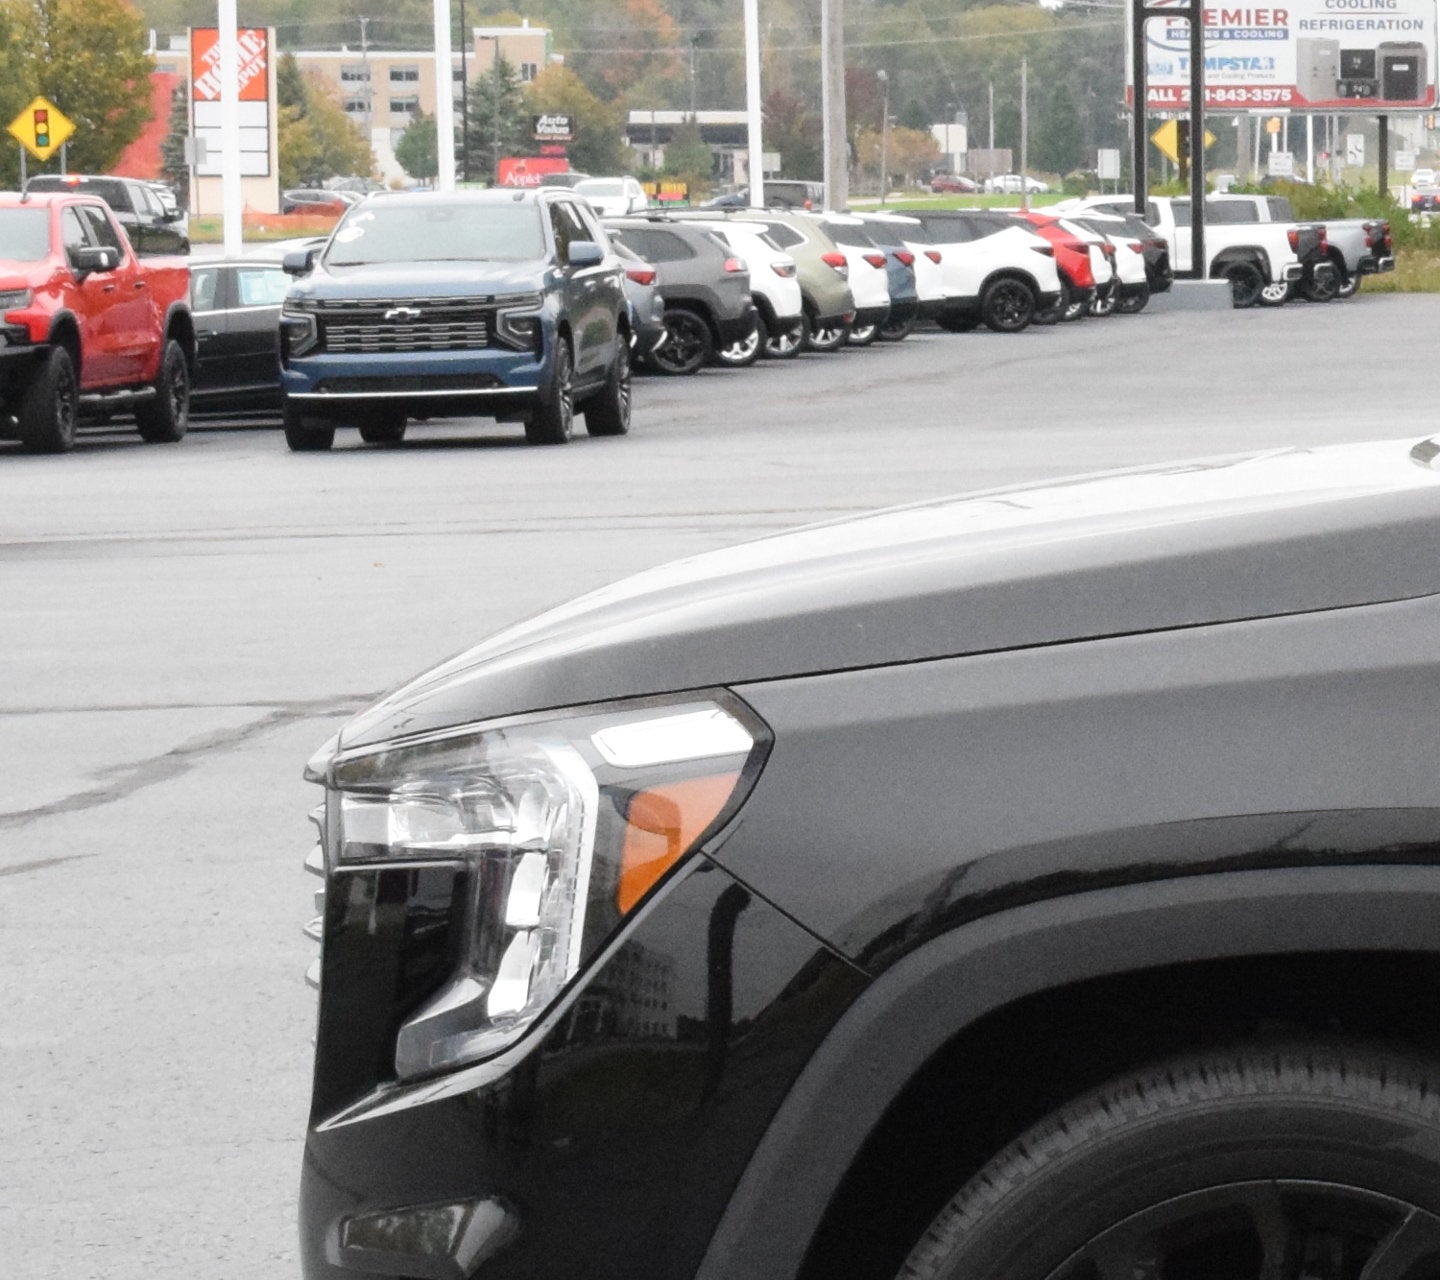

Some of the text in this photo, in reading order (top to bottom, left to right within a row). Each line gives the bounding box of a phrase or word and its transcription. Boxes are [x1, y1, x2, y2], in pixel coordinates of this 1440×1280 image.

[1299, 19, 1424, 31] REFRIGERATION
[1234, 30, 1284, 39] COOLING
[1148, 88, 1292, 102] ALL 21-843-3575
[538, 115, 569, 125] Auto
[536, 124, 570, 134] Value
